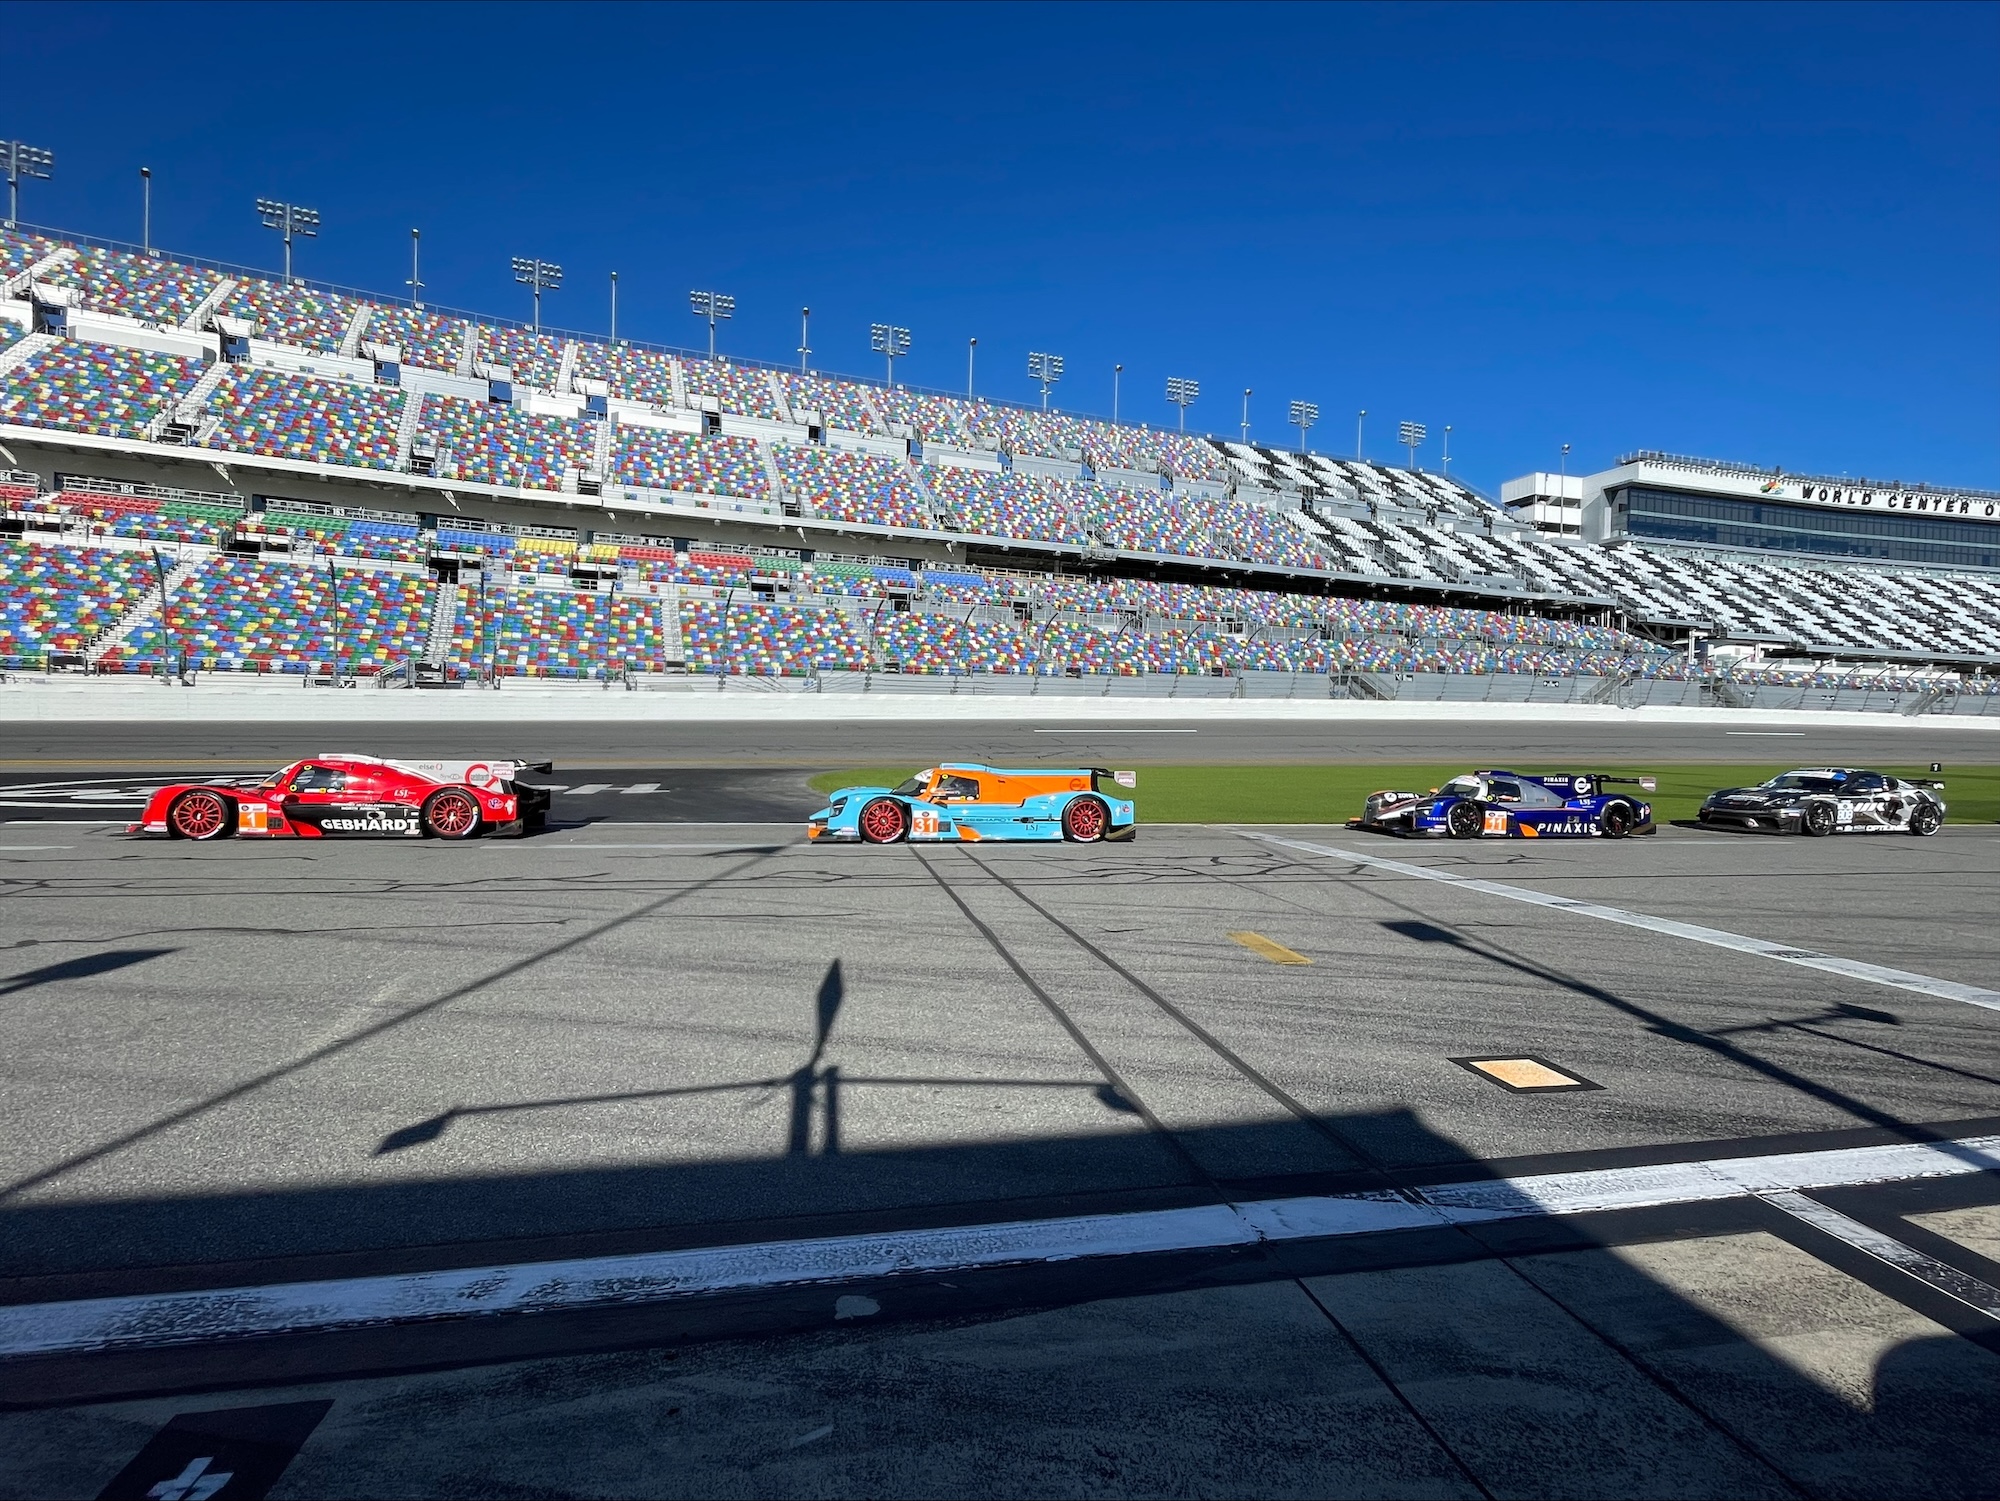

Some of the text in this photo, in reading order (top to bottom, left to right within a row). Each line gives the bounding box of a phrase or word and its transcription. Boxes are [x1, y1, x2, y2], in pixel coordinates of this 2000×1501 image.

[0, 472, 11, 481] 64
[120, 485, 134, 494] 164
[1802, 486, 1872, 506] WORLD
[1888, 495, 1969, 514] CENTER
[333, 507, 345, 516] 163
[491, 524, 502, 533] 162
[247, 812, 256, 828] 1
[320, 819, 420, 831] GEBHARDT
[915, 819, 935, 832] 31
[1489, 817, 1504, 830] 11
[1536, 823, 1598, 834] PINAXIS
